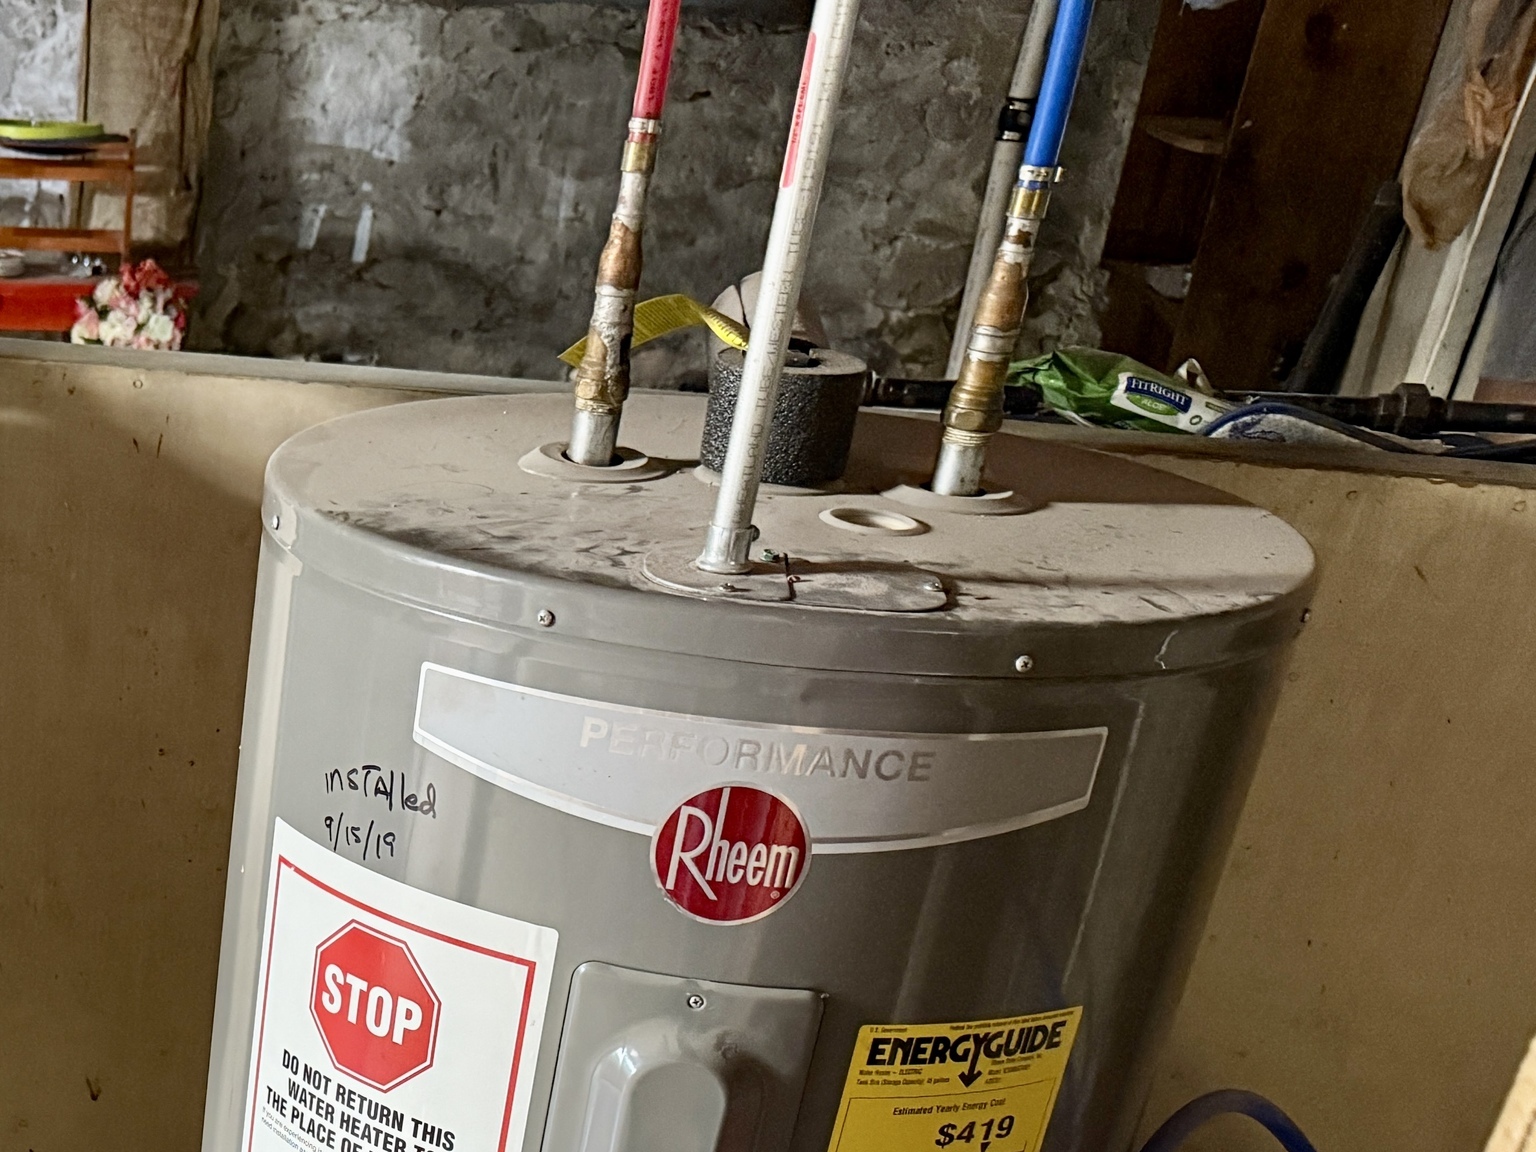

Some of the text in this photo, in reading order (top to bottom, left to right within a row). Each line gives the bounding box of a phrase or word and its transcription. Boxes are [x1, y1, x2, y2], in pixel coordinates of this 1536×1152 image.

[1130, 377, 1189, 407] FITRIGHT
[578, 715, 937, 783] PERFORMANCE
[324, 812, 397, 861] 9/15/19
[665, 788, 800, 902] Rheem
[321, 963, 424, 1046] STOP
[865, 1020, 1068, 1069] ENERGYGUIDE
[266, 1085, 288, 1119] THE
[291, 1105, 336, 1150] PLACE
[282, 1049, 456, 1152] DO NOT RETURN THIS
[288, 1078, 335, 1124] WATER
[893, 1098, 1007, 1116] Estimated Yearly Energy Cost
[284, 1124, 317, 1152] experiencing
[935, 1115, 1015, 1149] $419
